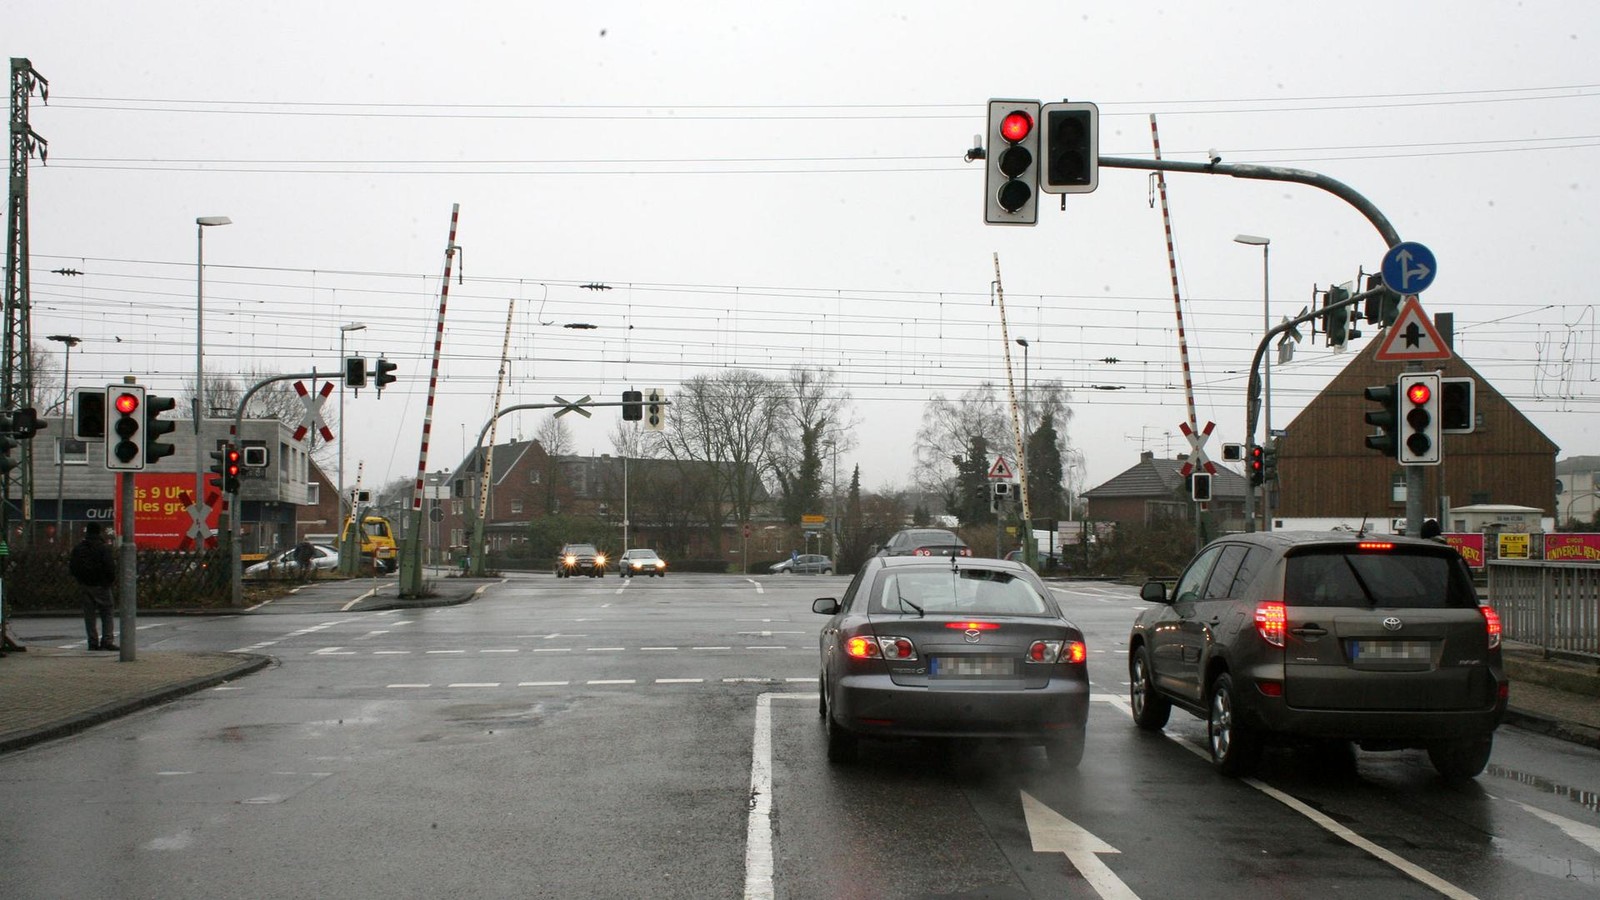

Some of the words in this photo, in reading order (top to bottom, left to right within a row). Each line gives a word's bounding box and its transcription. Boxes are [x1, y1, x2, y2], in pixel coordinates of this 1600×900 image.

[134, 486, 147, 499] is
[151, 486, 161, 499] 9
[134, 499, 160, 512] lles
[1462, 545, 1480, 562] RENZ
[1547, 545, 1583, 560] UNIVERSAL
